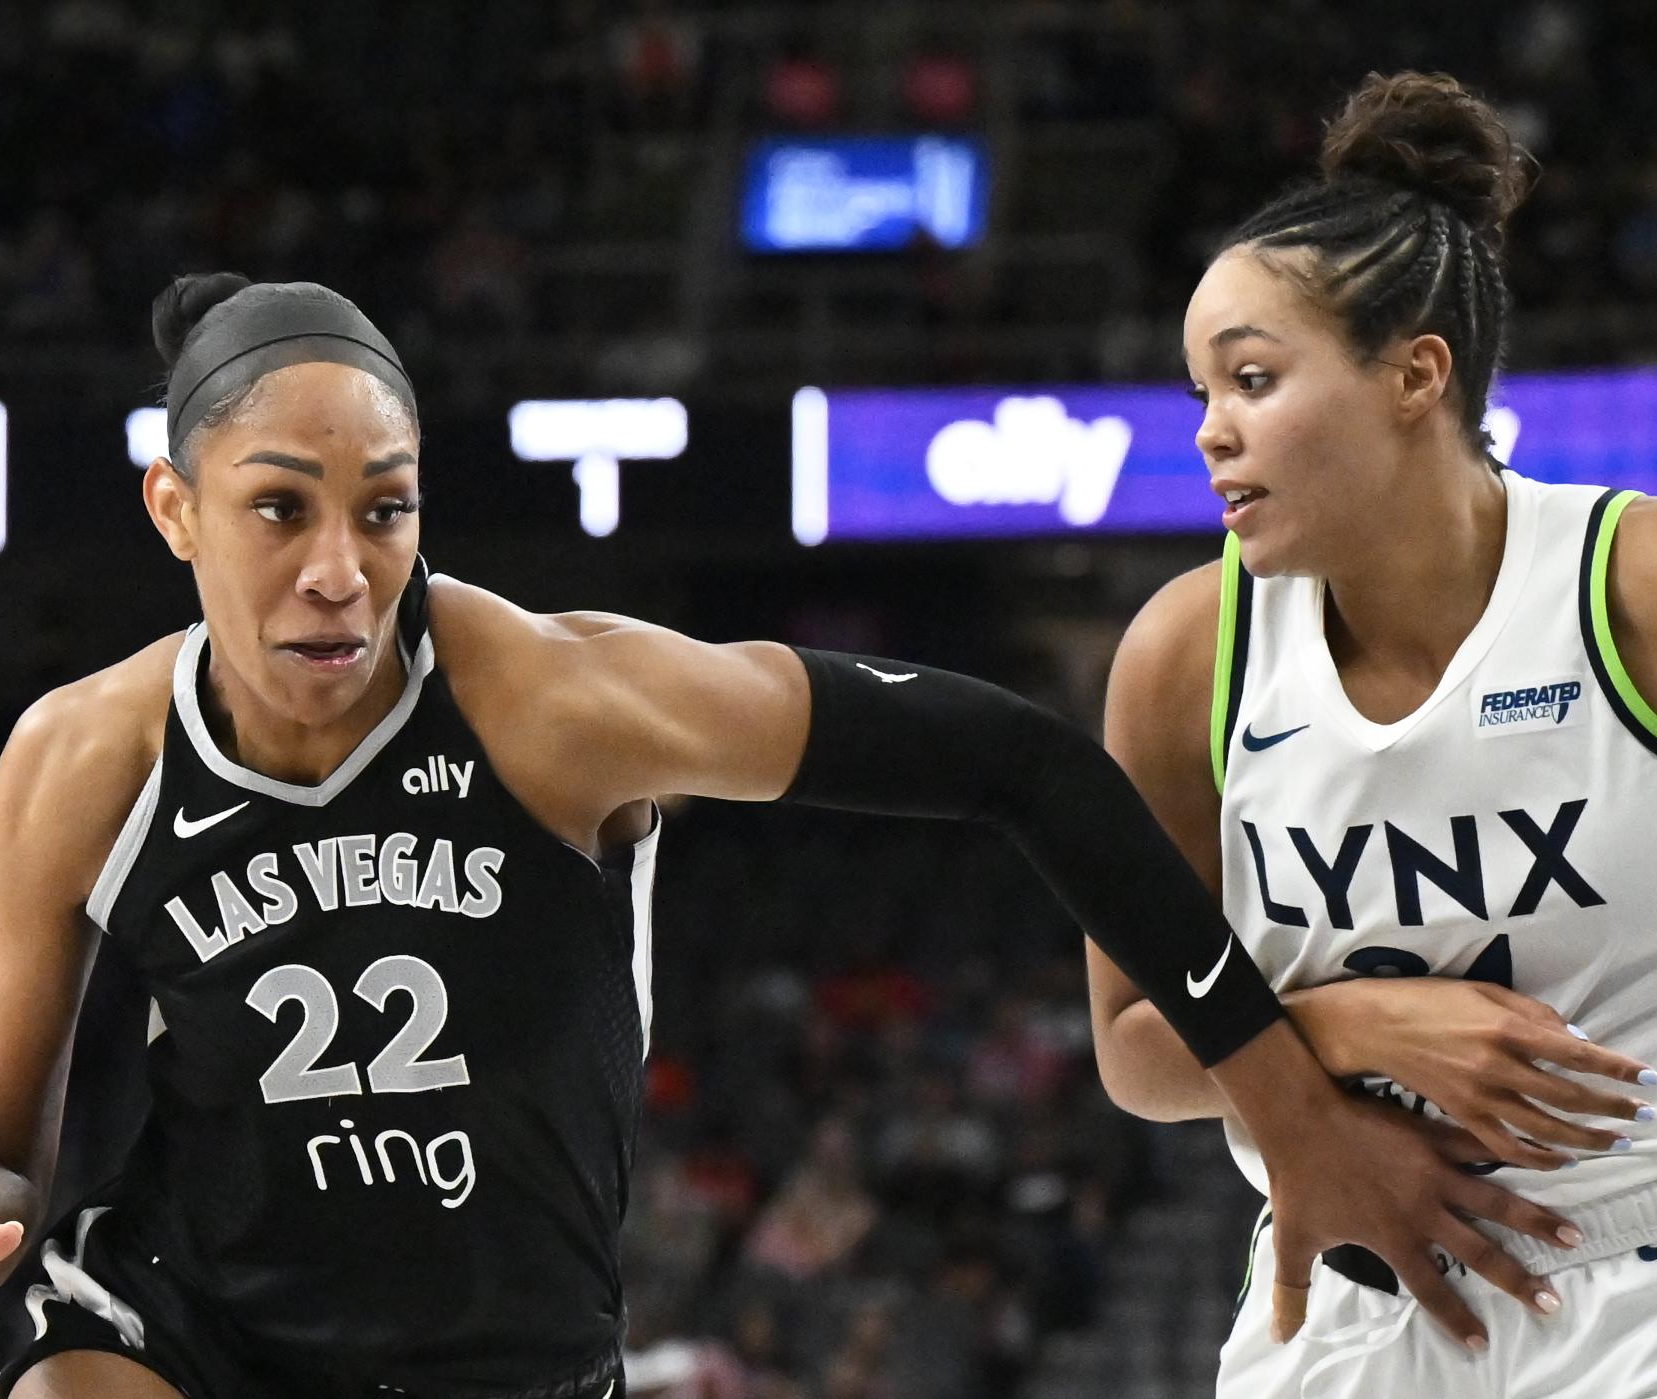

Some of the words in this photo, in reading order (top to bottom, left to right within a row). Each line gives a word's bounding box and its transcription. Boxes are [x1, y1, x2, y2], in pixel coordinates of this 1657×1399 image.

[927, 396, 1131, 525] ally
[1478, 704, 1552, 727] INSURANCE
[1480, 681, 1581, 714] FEDERATED
[402, 755, 475, 798] ally
[164, 852, 298, 963] LAS
[292, 832, 505, 918] VEGAS
[1240, 798, 1607, 930] LYNX
[245, 955, 470, 1104] 22
[306, 1119, 476, 1208] ring
